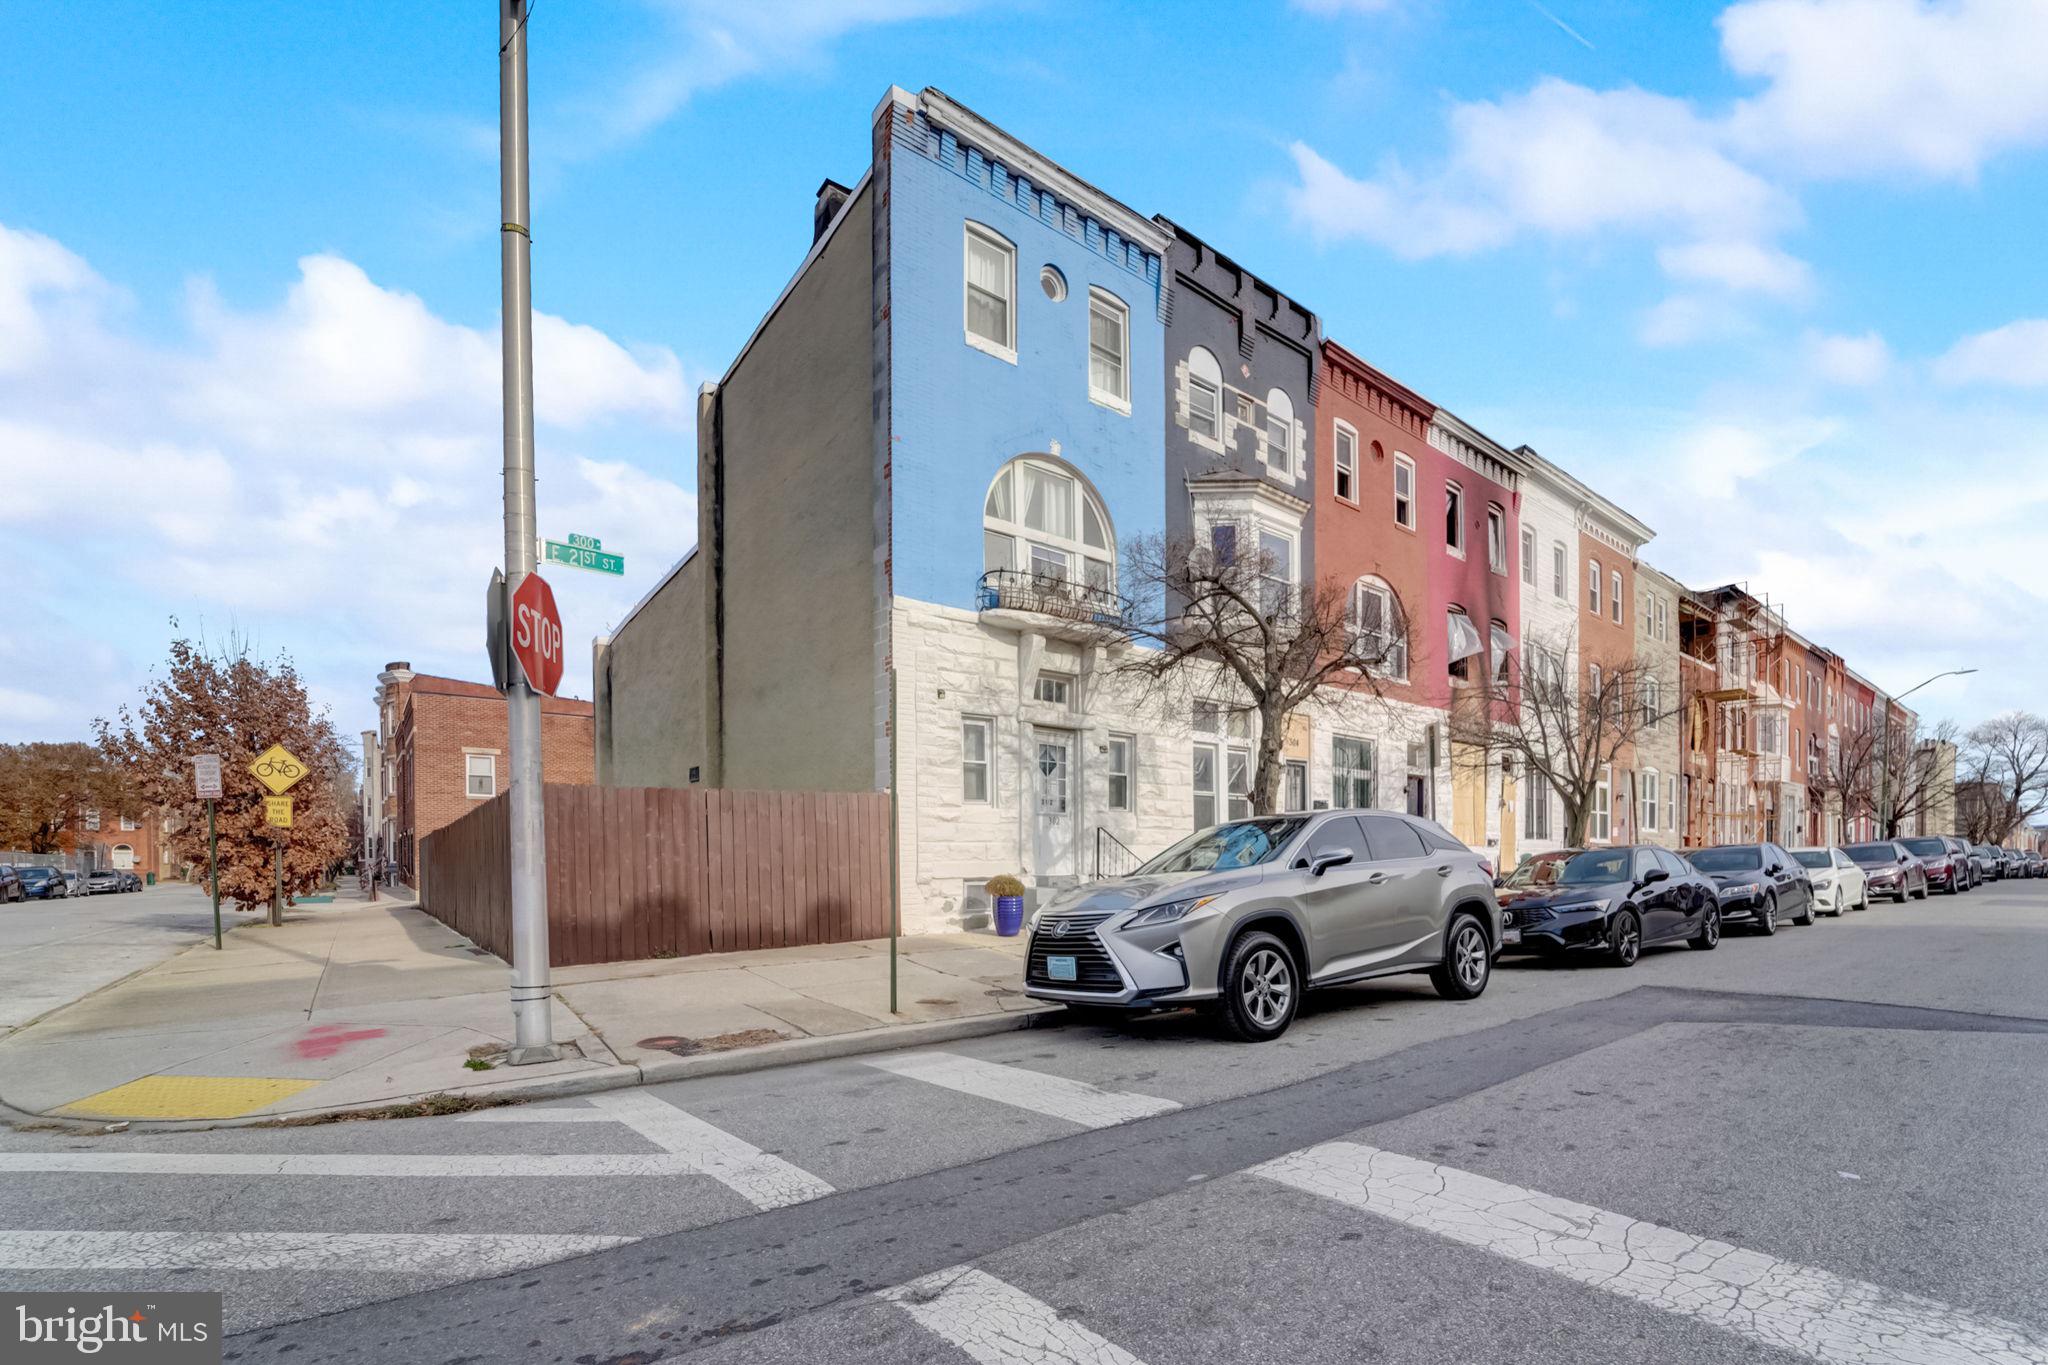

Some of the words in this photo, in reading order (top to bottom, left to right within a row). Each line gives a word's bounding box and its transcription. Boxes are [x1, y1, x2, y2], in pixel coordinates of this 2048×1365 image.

[573, 534, 594, 549] 300
[568, 548, 597, 567] 21ST
[602, 558, 617, 571] ST.
[517, 603, 561, 664] STOP
